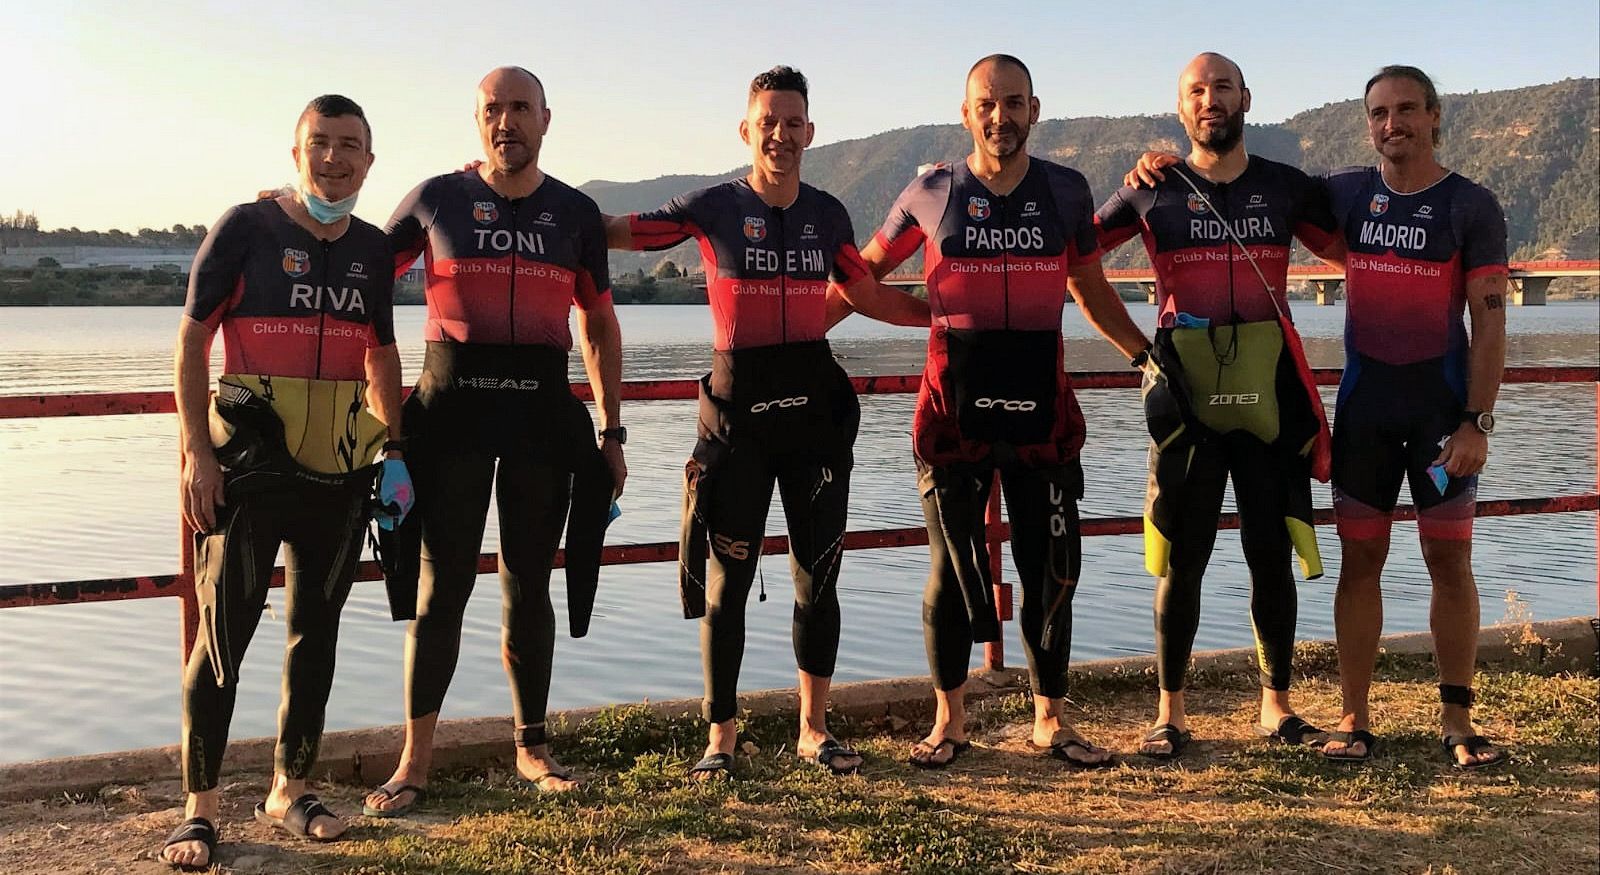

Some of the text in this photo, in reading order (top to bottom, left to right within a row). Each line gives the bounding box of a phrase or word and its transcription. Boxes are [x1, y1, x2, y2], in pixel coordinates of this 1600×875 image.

[1190, 216, 1276, 240] RIDAURA
[1359, 221, 1427, 251] MADRID
[474, 229, 546, 255] TONI
[965, 226, 1045, 250] PARDOS
[802, 249, 825, 272] HM
[1174, 252, 1203, 264] Club
[1350, 257, 1368, 270] Club
[1369, 260, 1412, 275] Natació
[449, 263, 482, 275] Club
[486, 263, 547, 278] Natació
[950, 262, 979, 274] Club
[982, 261, 1033, 273] Natació
[731, 284, 757, 295] Club
[759, 284, 809, 296] Natació
[289, 284, 365, 315] RIVA
[252, 322, 288, 335] Club
[292, 322, 353, 338] Natació
[750, 396, 809, 413] orca
[975, 397, 1037, 411] orca
